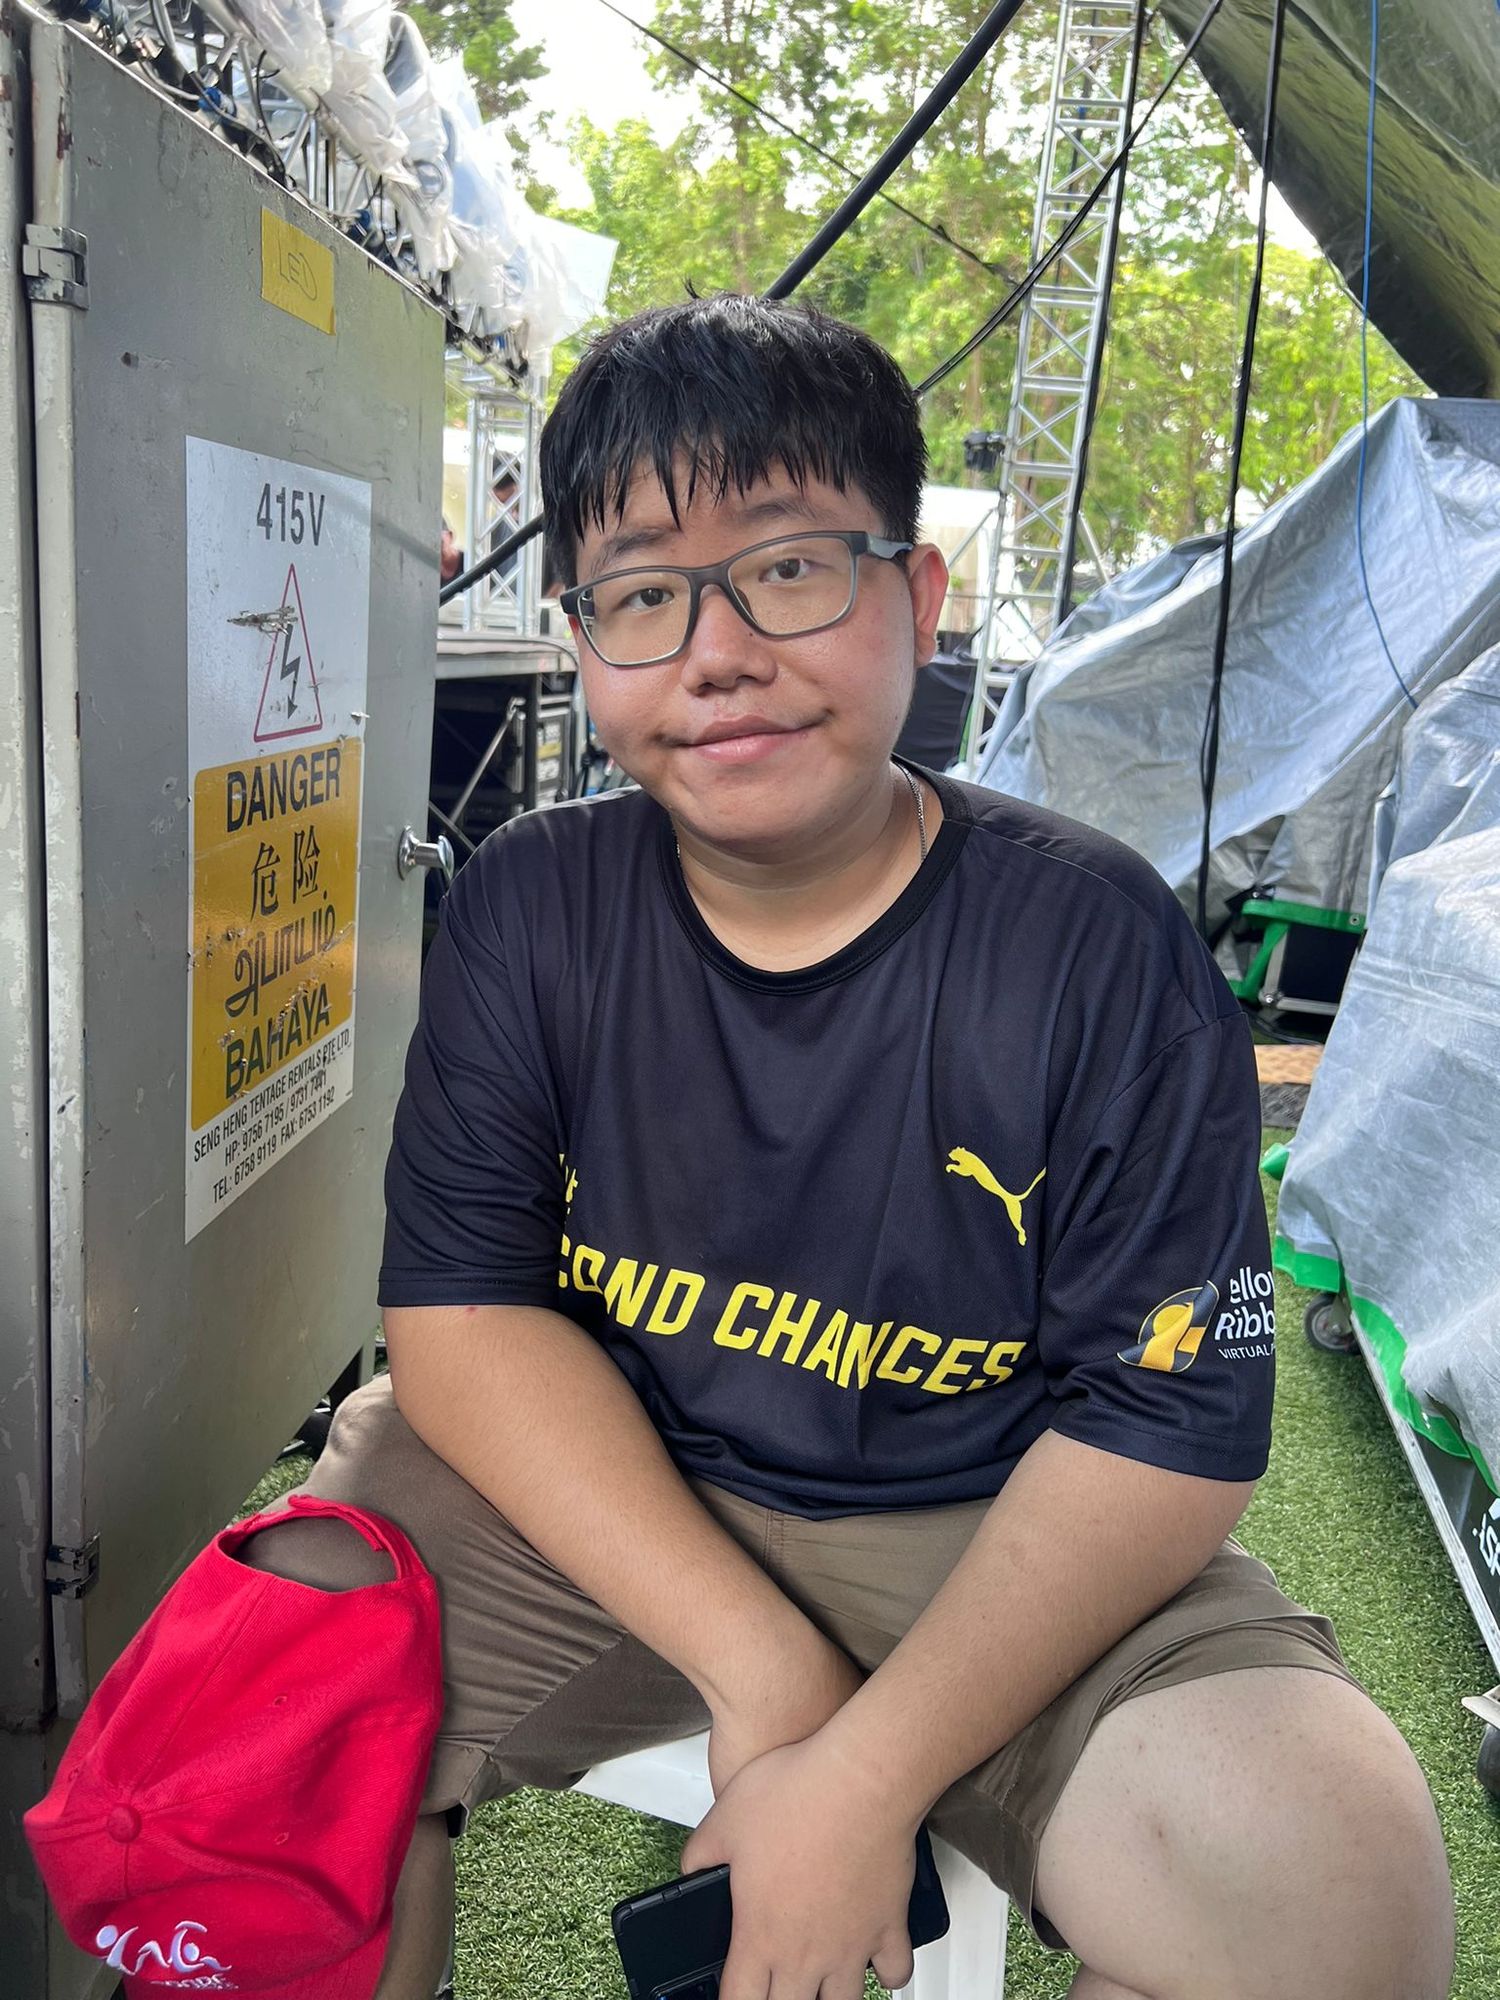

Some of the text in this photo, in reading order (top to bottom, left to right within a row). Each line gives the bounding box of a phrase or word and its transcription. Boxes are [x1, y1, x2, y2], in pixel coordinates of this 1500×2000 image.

[277, 231, 317, 301] LED
[257, 483, 325, 546] 415V
[227, 747, 341, 833] DANGER
[251, 825, 320, 921] 危险
[226, 983, 330, 1099] BAHAYA
[194, 1125, 220, 1162] SENG
[223, 1105, 247, 1140] HENG
[250, 1074, 286, 1117] TENTAGE
[288, 1049, 321, 1089] RENTALS
[323, 1038, 336, 1063] PTE
[213, 1086, 335, 1203] TEL: 6758 9119 FAX: 6753 1192
[225, 1140, 240, 1167] HP:
[243, 1120, 262, 1151] 9756
[265, 1102, 284, 1132] 7195
[291, 1081, 309, 1112] 9731
[713, 1282, 1027, 1395] CHANCES
